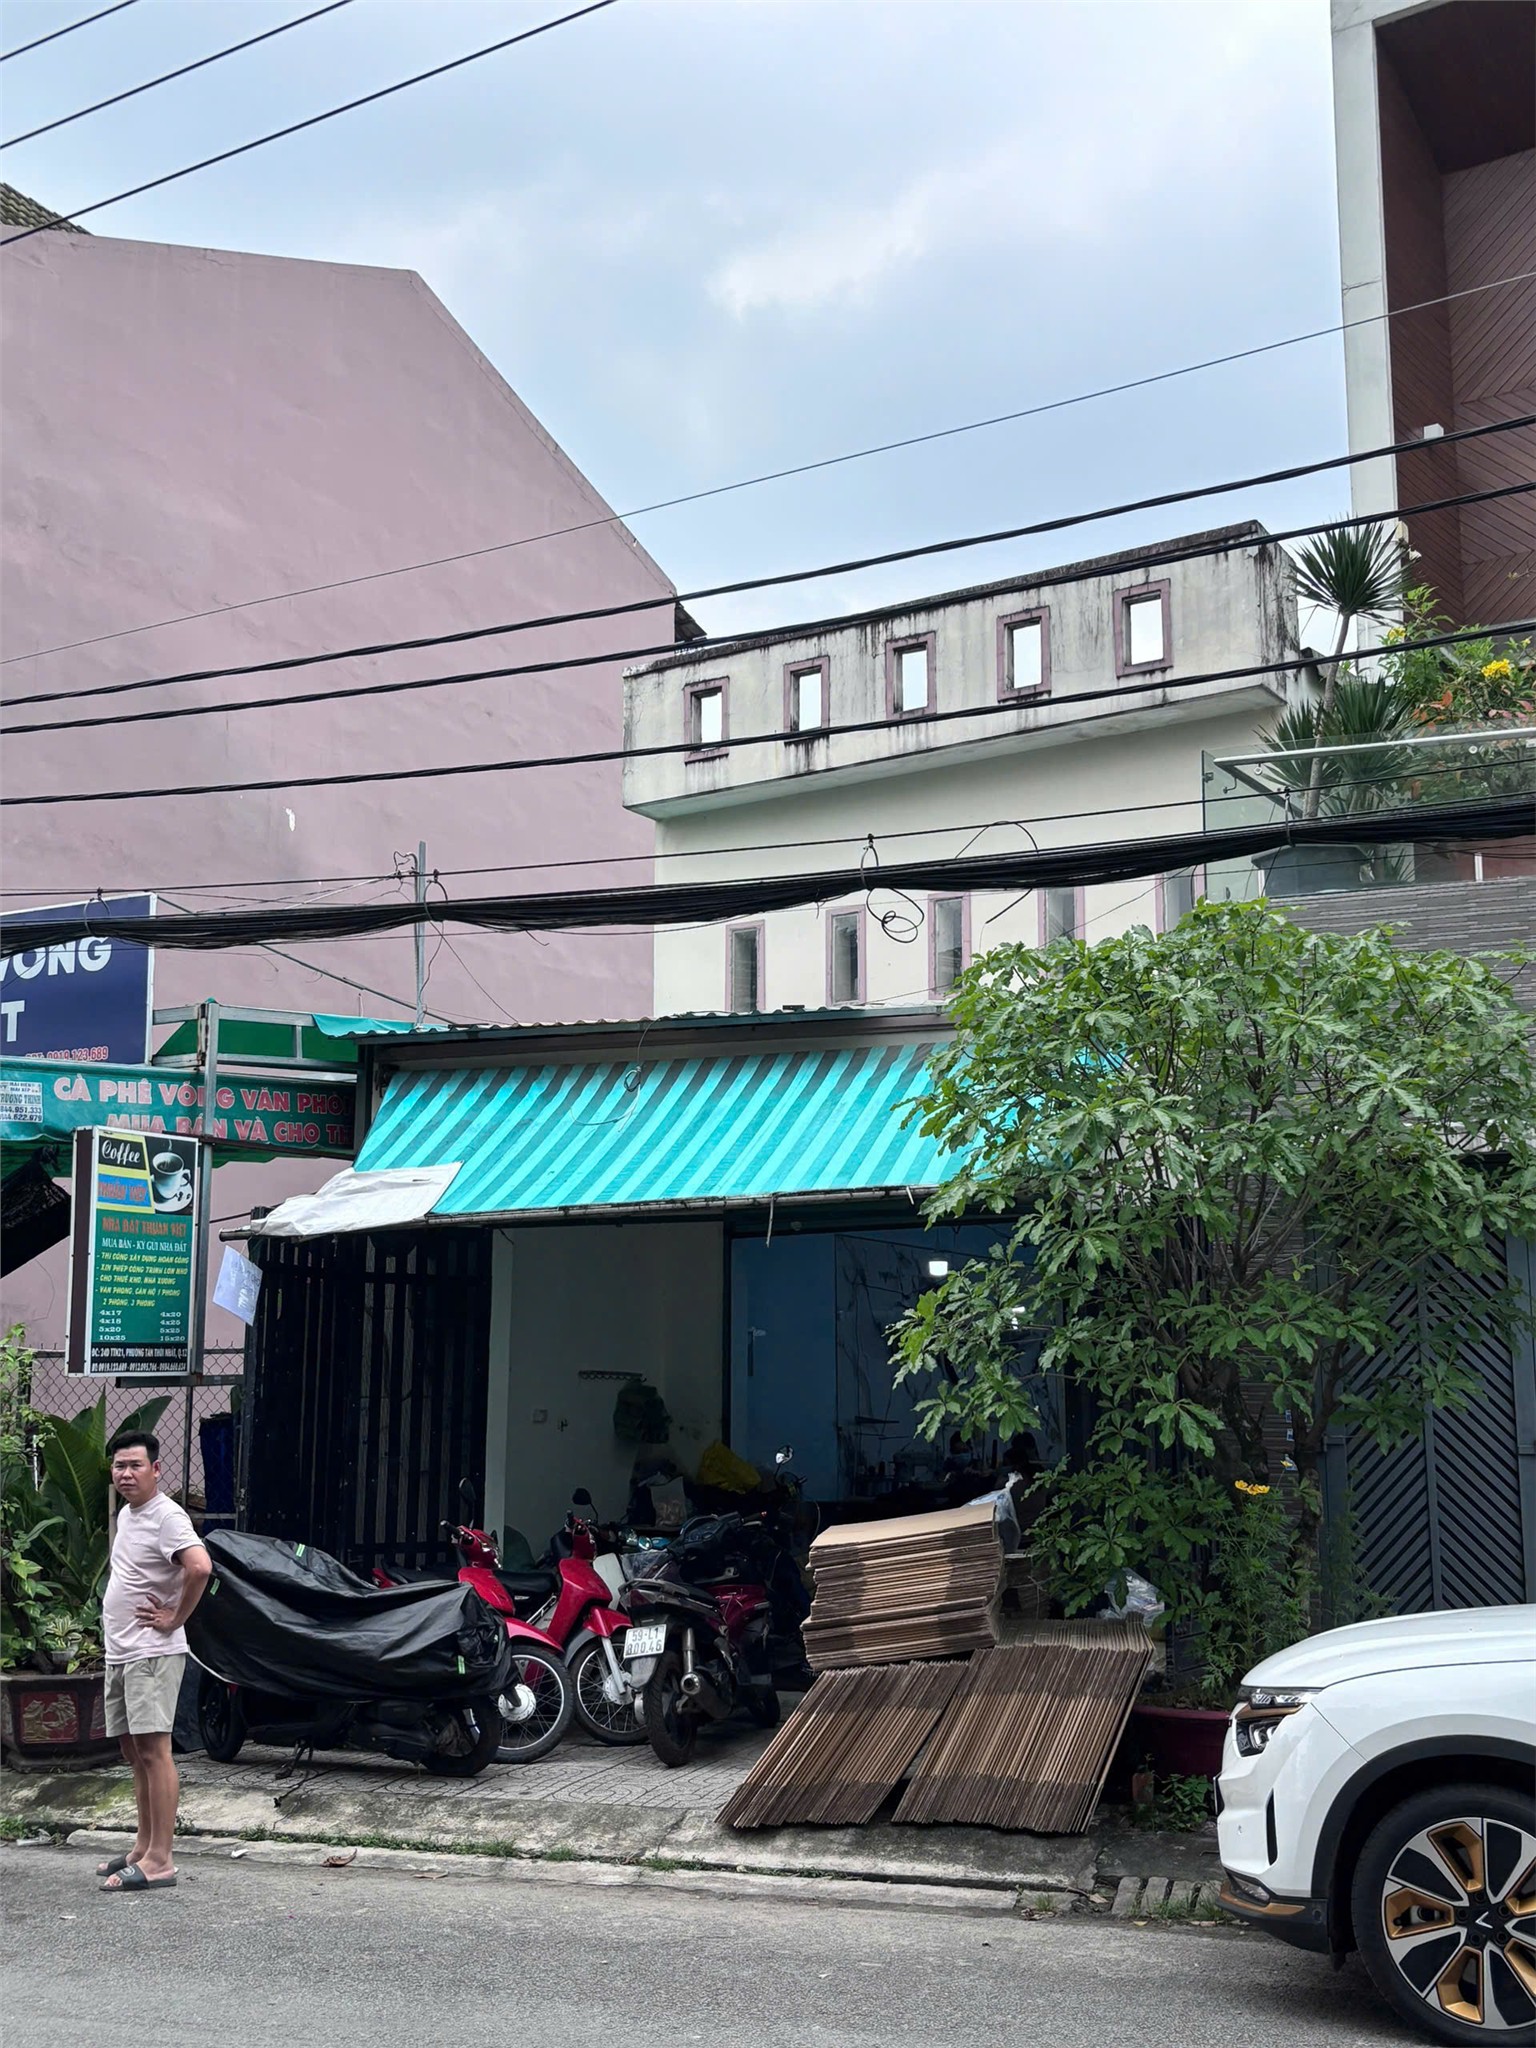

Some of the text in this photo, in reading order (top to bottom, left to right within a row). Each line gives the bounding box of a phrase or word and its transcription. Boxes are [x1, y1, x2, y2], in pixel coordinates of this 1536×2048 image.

[53, 1073, 91, 1102] CÀ
[98, 1078, 153, 1105] PHÊ
[240, 1086, 290, 1113] VĂN
[106, 1113, 166, 1134] MUA
[175, 1113, 228, 1139] BÁN
[234, 1117, 268, 1142] VÀ
[274, 1121, 321, 1144] CHO
[101, 1139, 141, 1165] Coffee
[631, 1626, 659, 1642] 59-L1
